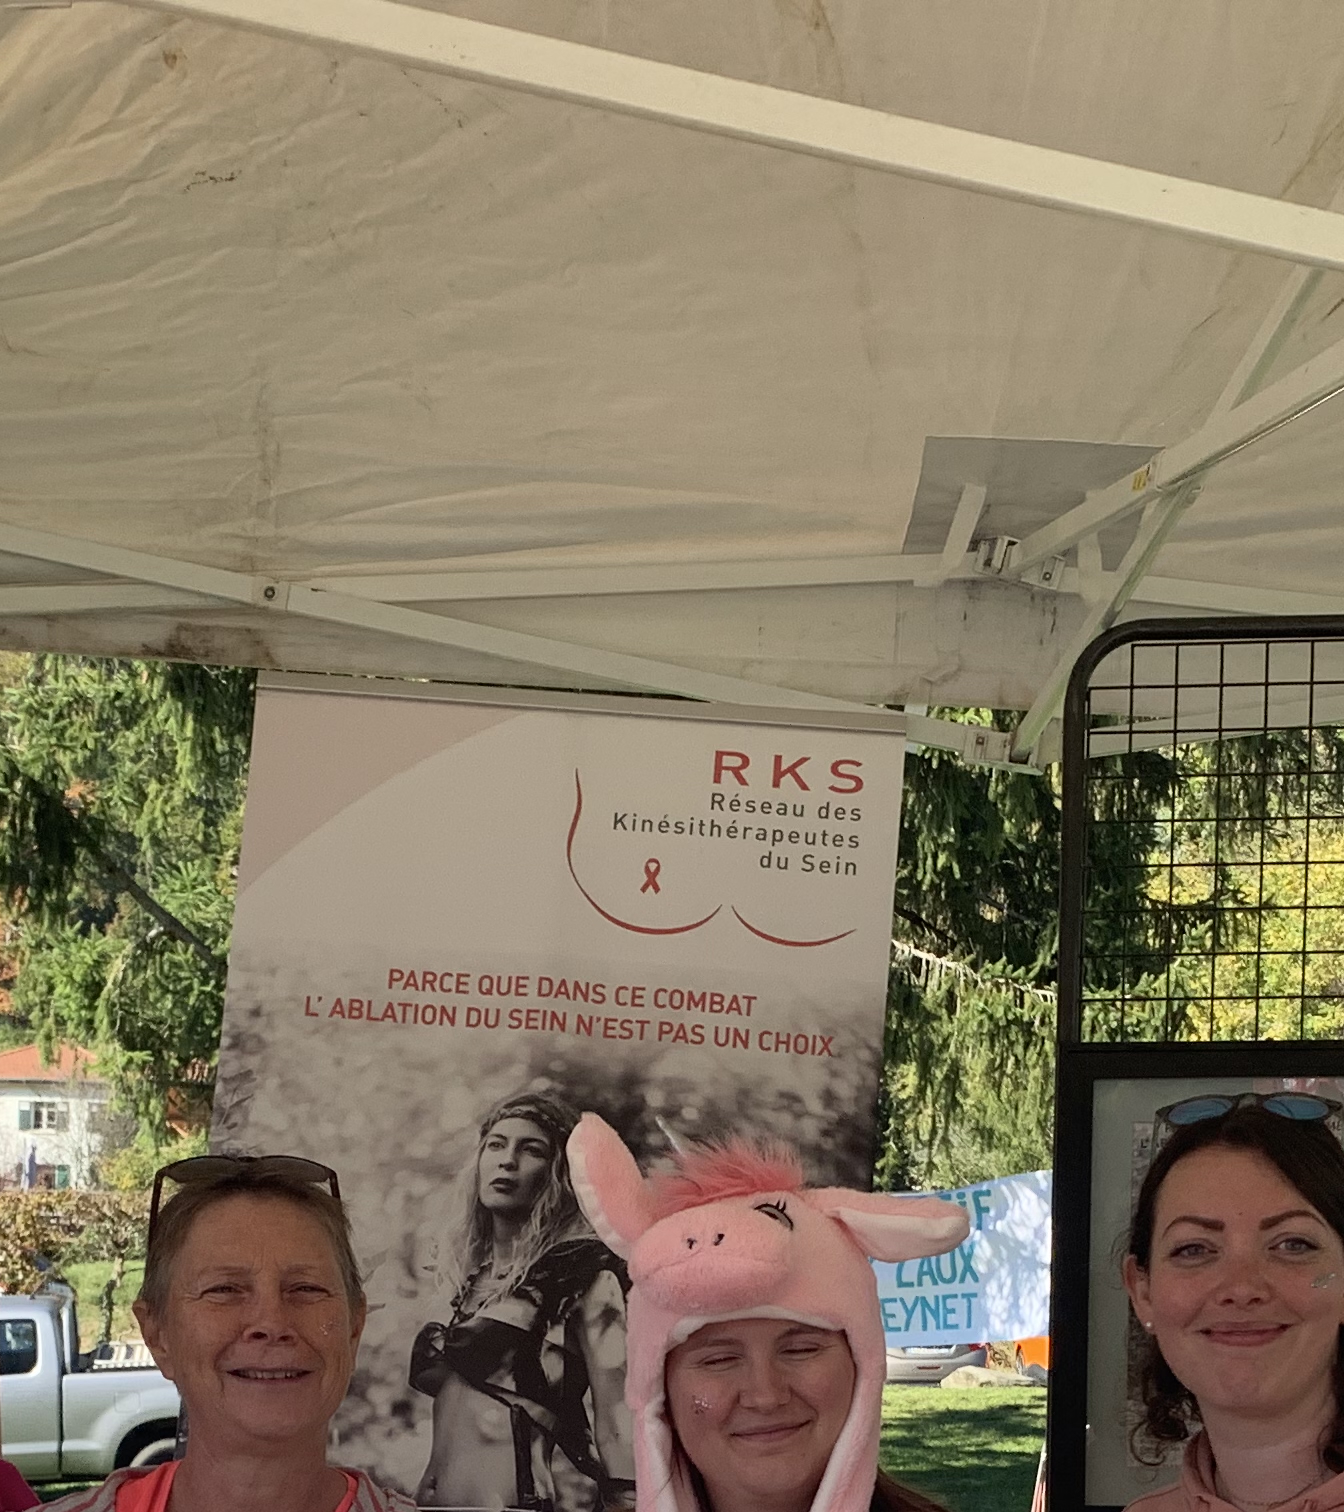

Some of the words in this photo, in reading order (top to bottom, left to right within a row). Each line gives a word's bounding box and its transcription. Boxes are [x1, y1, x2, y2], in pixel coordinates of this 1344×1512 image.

[712, 750, 864, 794] RKS
[710, 792, 805, 818] Réseau
[817, 801, 862, 822] des
[612, 811, 862, 849] Kinésithérapeutes
[759, 850, 789, 871] du
[801, 853, 857, 876] Sein
[387, 968, 471, 995] PARCE
[477, 974, 530, 997] QUE
[537, 976, 607, 1005] DANS
[614, 985, 647, 1008] CE
[653, 987, 758, 1017] COMBAT
[327, 997, 457, 1027] ABLATION
[465, 1006, 501, 1029] DU
[507, 1008, 567, 1033] SEIN
[575, 1013, 651, 1041] N'EST
[657, 1020, 705, 1046] PAS
[713, 1025, 750, 1050] UN
[758, 1027, 838, 1056] CHOIX
[880, 1293, 978, 1332] EYNET
